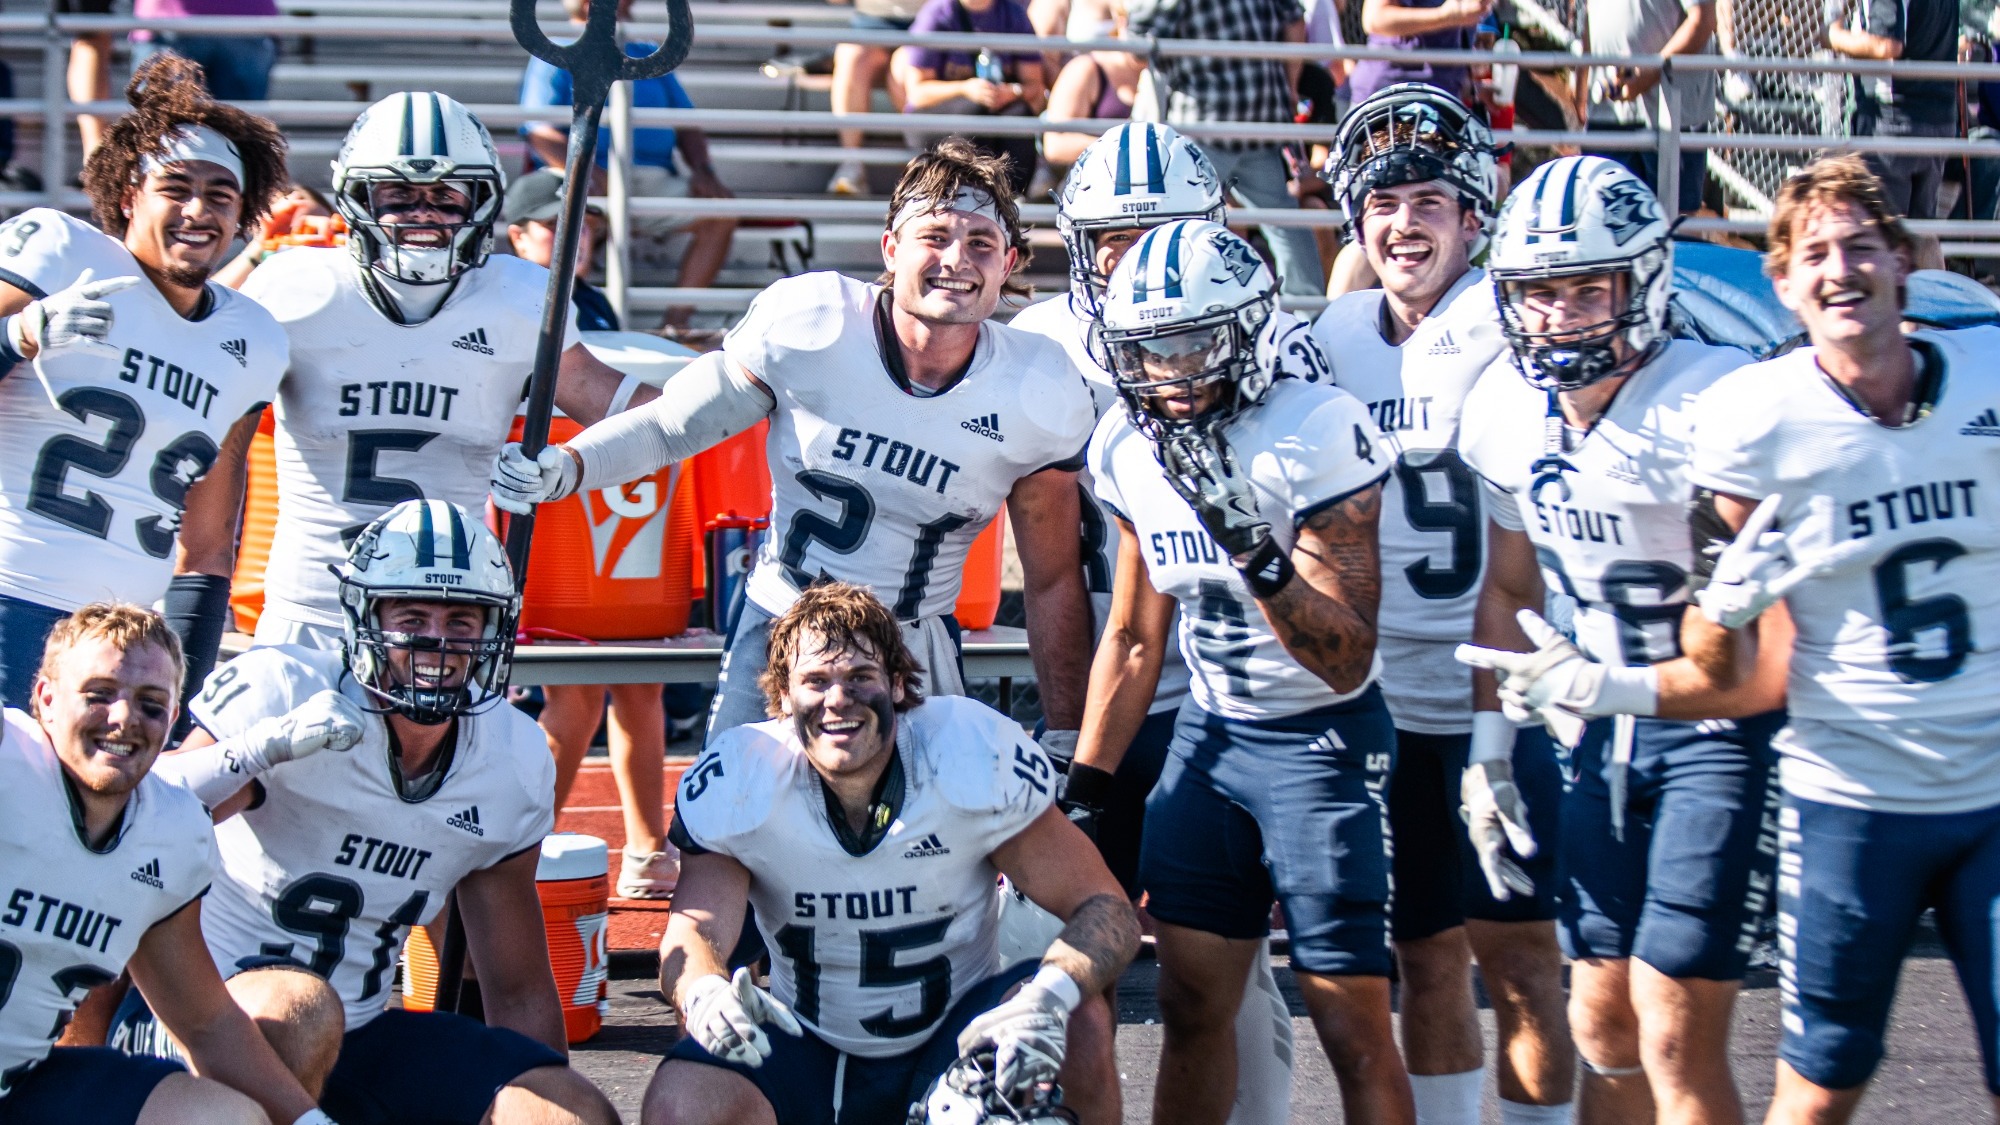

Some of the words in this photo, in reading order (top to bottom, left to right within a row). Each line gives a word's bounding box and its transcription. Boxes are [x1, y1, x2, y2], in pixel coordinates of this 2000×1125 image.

[1122, 202, 1157, 213] STOUT
[1139, 306, 1173, 320] STOUT
[220, 342, 247, 368] adidas
[452, 339, 494, 355] adidas
[1288, 334, 1330, 383] 36
[119, 348, 219, 419] STOUT
[339, 381, 458, 421] STOUT
[960, 420, 1004, 442] adidas
[1366, 396, 1433, 432] TOUT
[1959, 427, 2000, 437] adida
[832, 428, 960, 494] STOUT
[1353, 423, 1376, 465] 4
[26, 386, 221, 559] 29
[1398, 448, 1482, 599] 9
[1536, 501, 1623, 546] STOUT
[1848, 480, 1977, 540] STOUT
[780, 469, 973, 618] 21
[1151, 530, 1232, 568] STOU
[425, 573, 462, 585] STOUT
[1871, 537, 1974, 683] 6
[202, 666, 251, 716] 91
[420, 694, 445, 702] Riddll
[682, 751, 725, 802] 15
[1013, 744, 1050, 796] 15
[446, 816, 484, 836] adidas
[335, 834, 432, 880] STOUT
[904, 847, 950, 859] adidas
[131, 870, 164, 889] adidas
[2, 888, 122, 952] STOUT
[795, 885, 917, 920] STOUT
[261, 872, 431, 1001] 91
[774, 917, 958, 1039] 15
